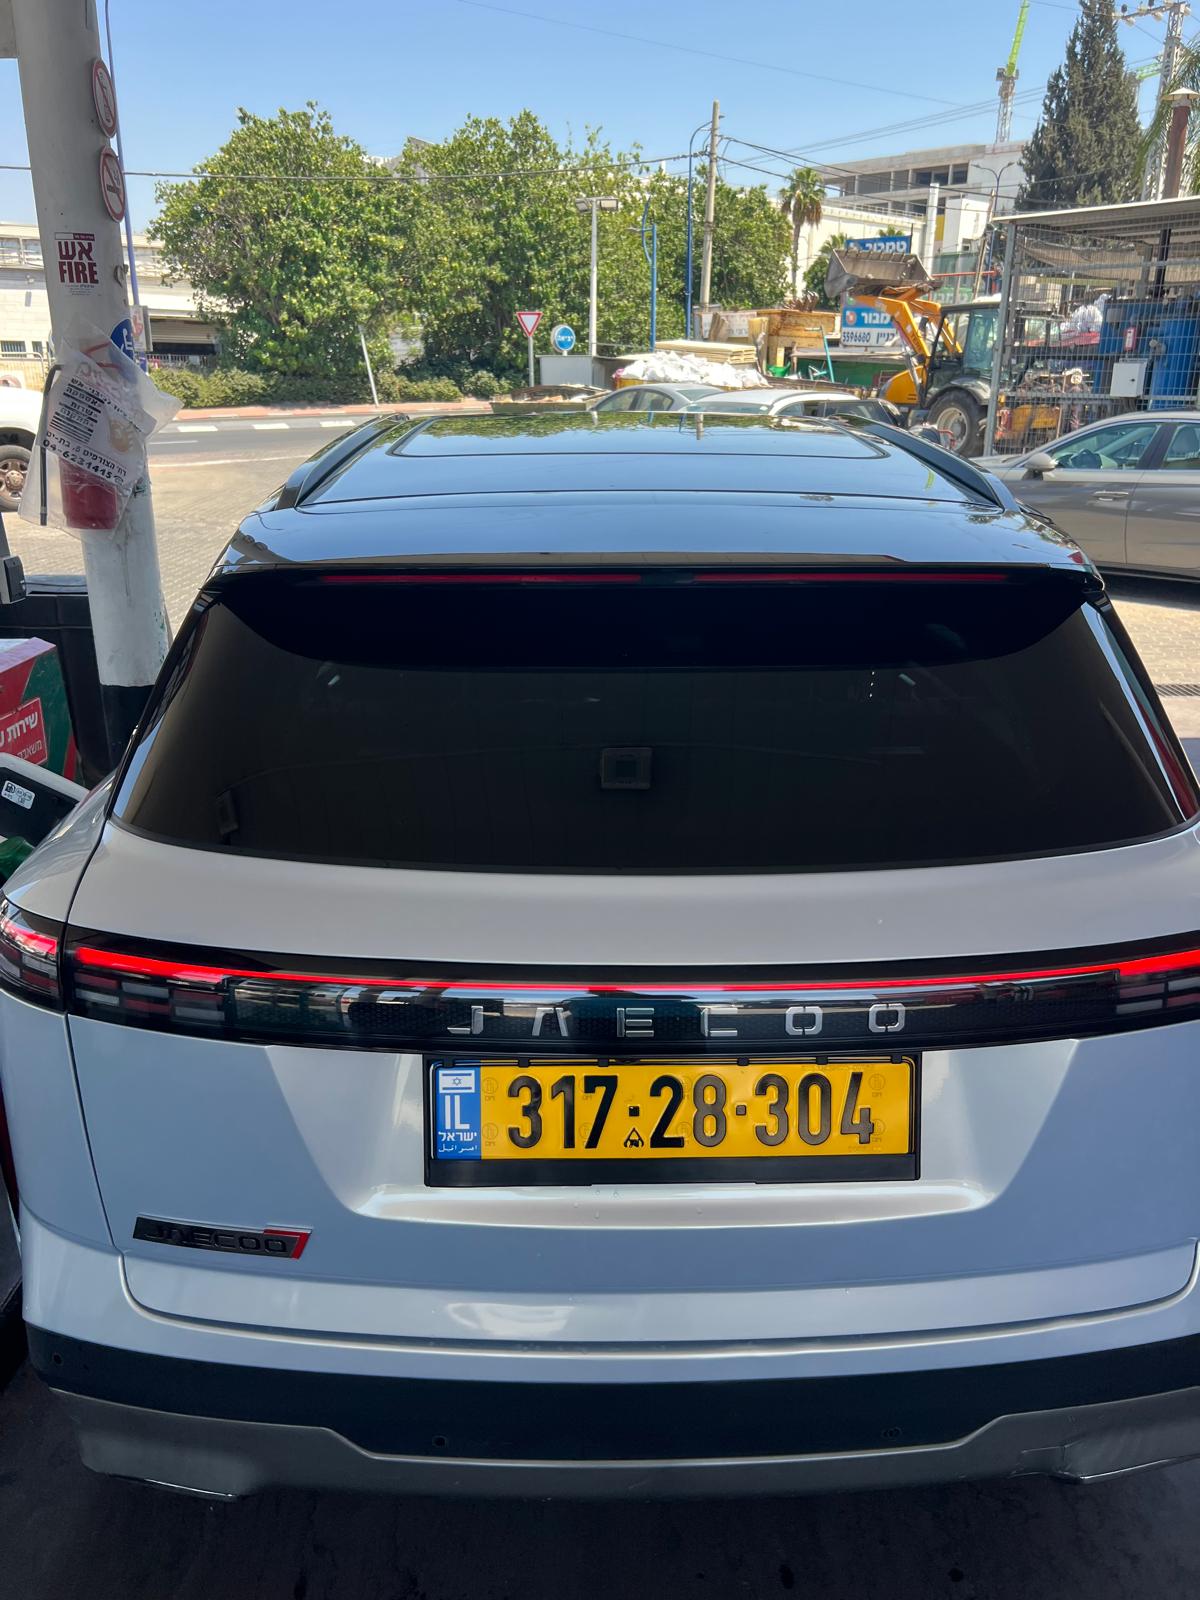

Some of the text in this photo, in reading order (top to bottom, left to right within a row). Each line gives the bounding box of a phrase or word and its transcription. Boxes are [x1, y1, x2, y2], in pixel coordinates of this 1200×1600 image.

[58, 241, 93, 261] אש
[58, 261, 99, 284] FIRE
[861, 312, 891, 324] מבור
[6, 711, 39, 743] שירות
[444, 1094, 470, 1130] IL
[438, 1131, 477, 1142] ישראל
